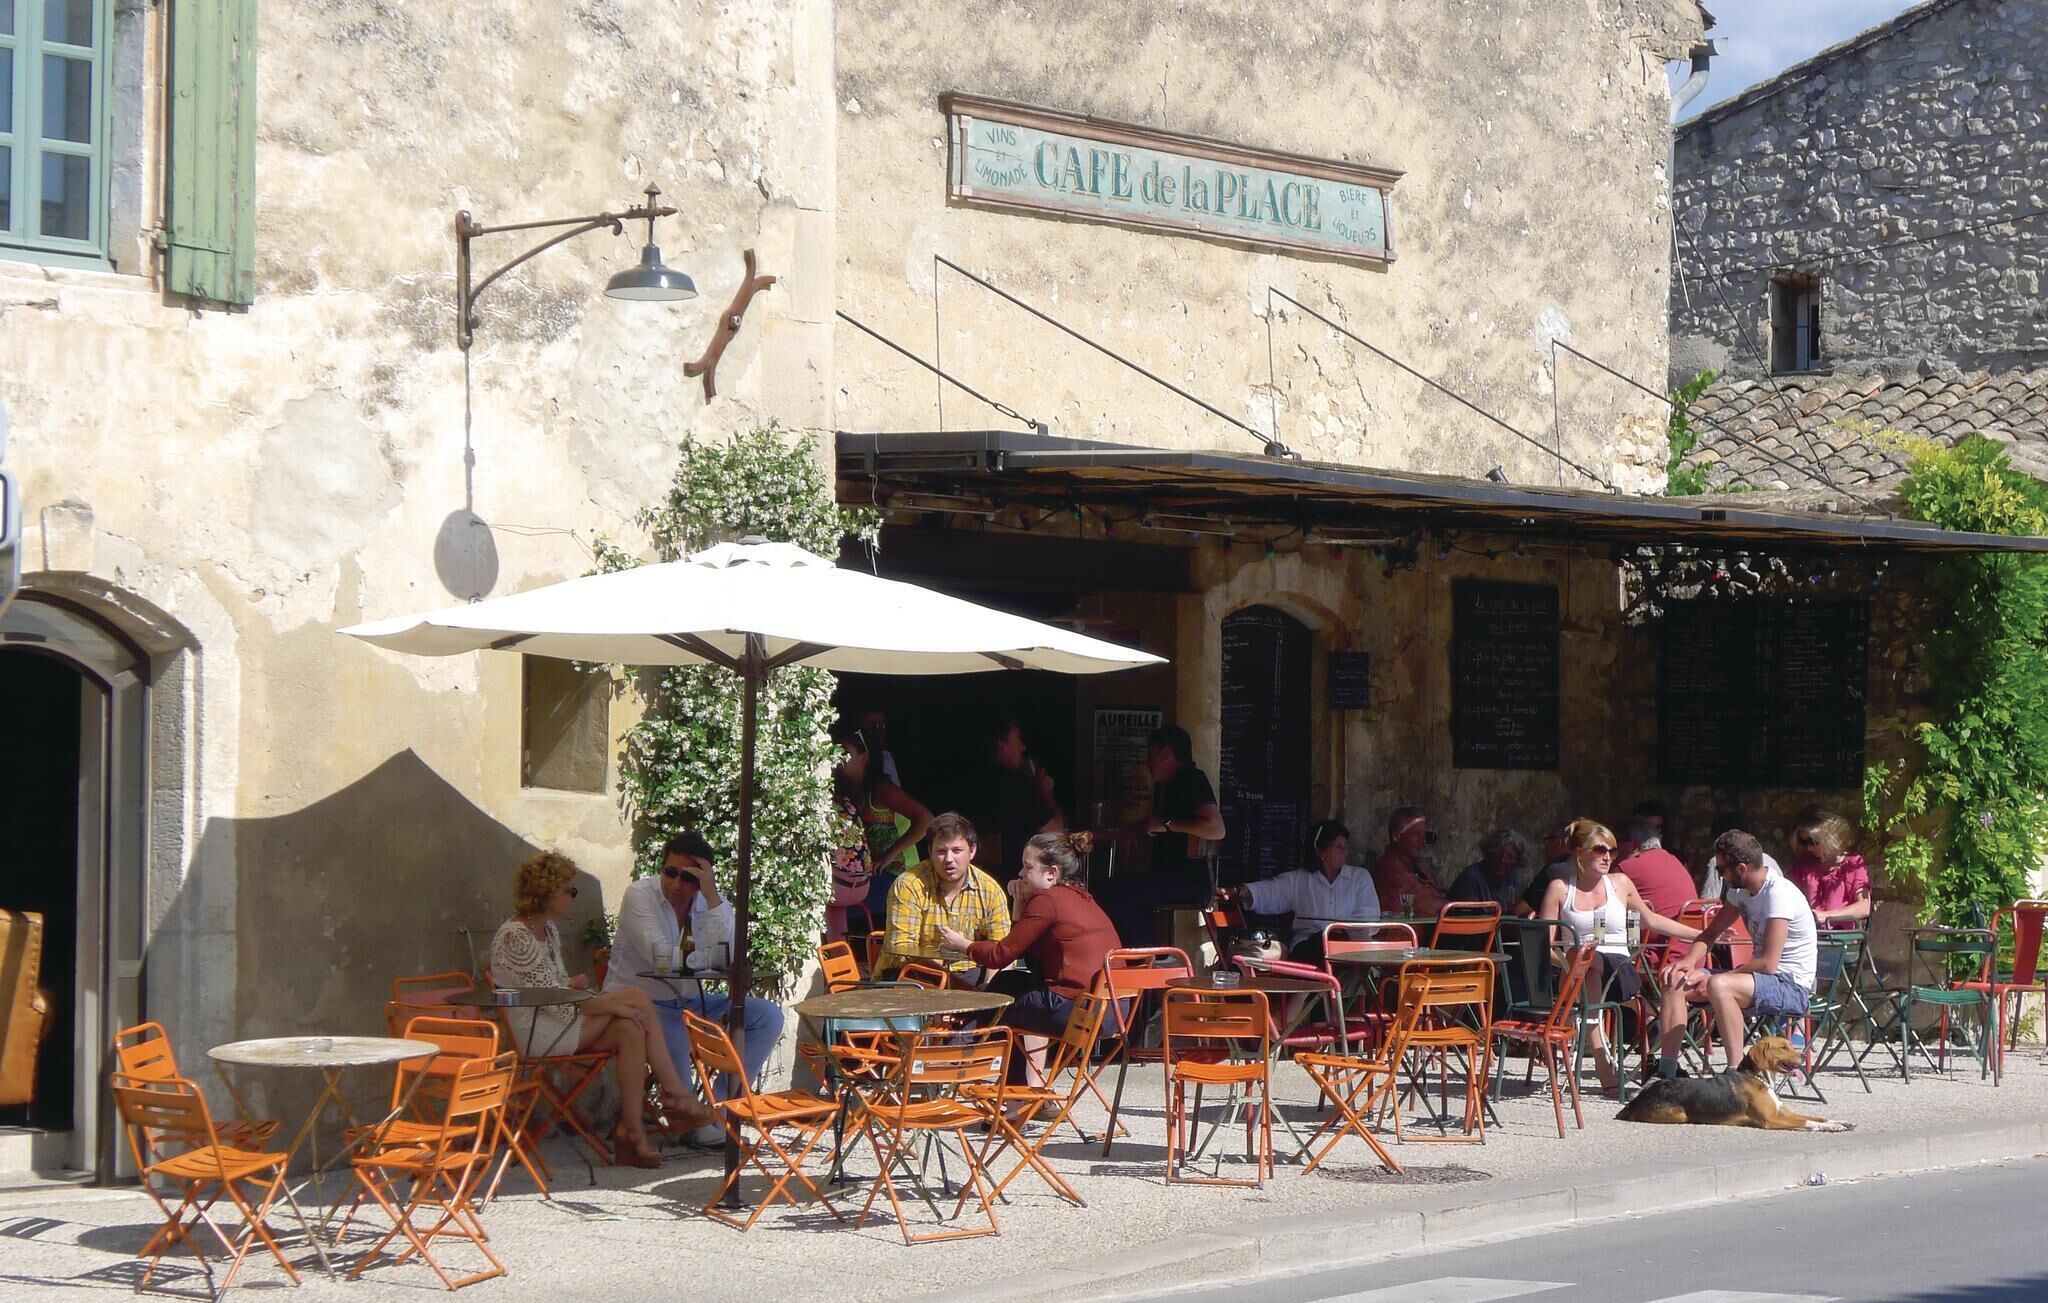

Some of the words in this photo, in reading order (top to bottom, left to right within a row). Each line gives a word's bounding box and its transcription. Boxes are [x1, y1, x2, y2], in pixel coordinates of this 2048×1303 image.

[986, 127, 1016, 146] VINS
[996, 149, 1006, 161] ET
[975, 158, 1028, 187] LIMONADE
[1034, 139, 1133, 201] CAFE
[1140, 159, 1177, 207] de
[1181, 164, 1209, 213] la
[1213, 169, 1322, 231] PLACE
[1339, 188, 1368, 206] BIERE
[1350, 209, 1359, 220] ET
[1332, 216, 1377, 244] LIQUEURS
[1097, 713, 1159, 727] AUREILLE
